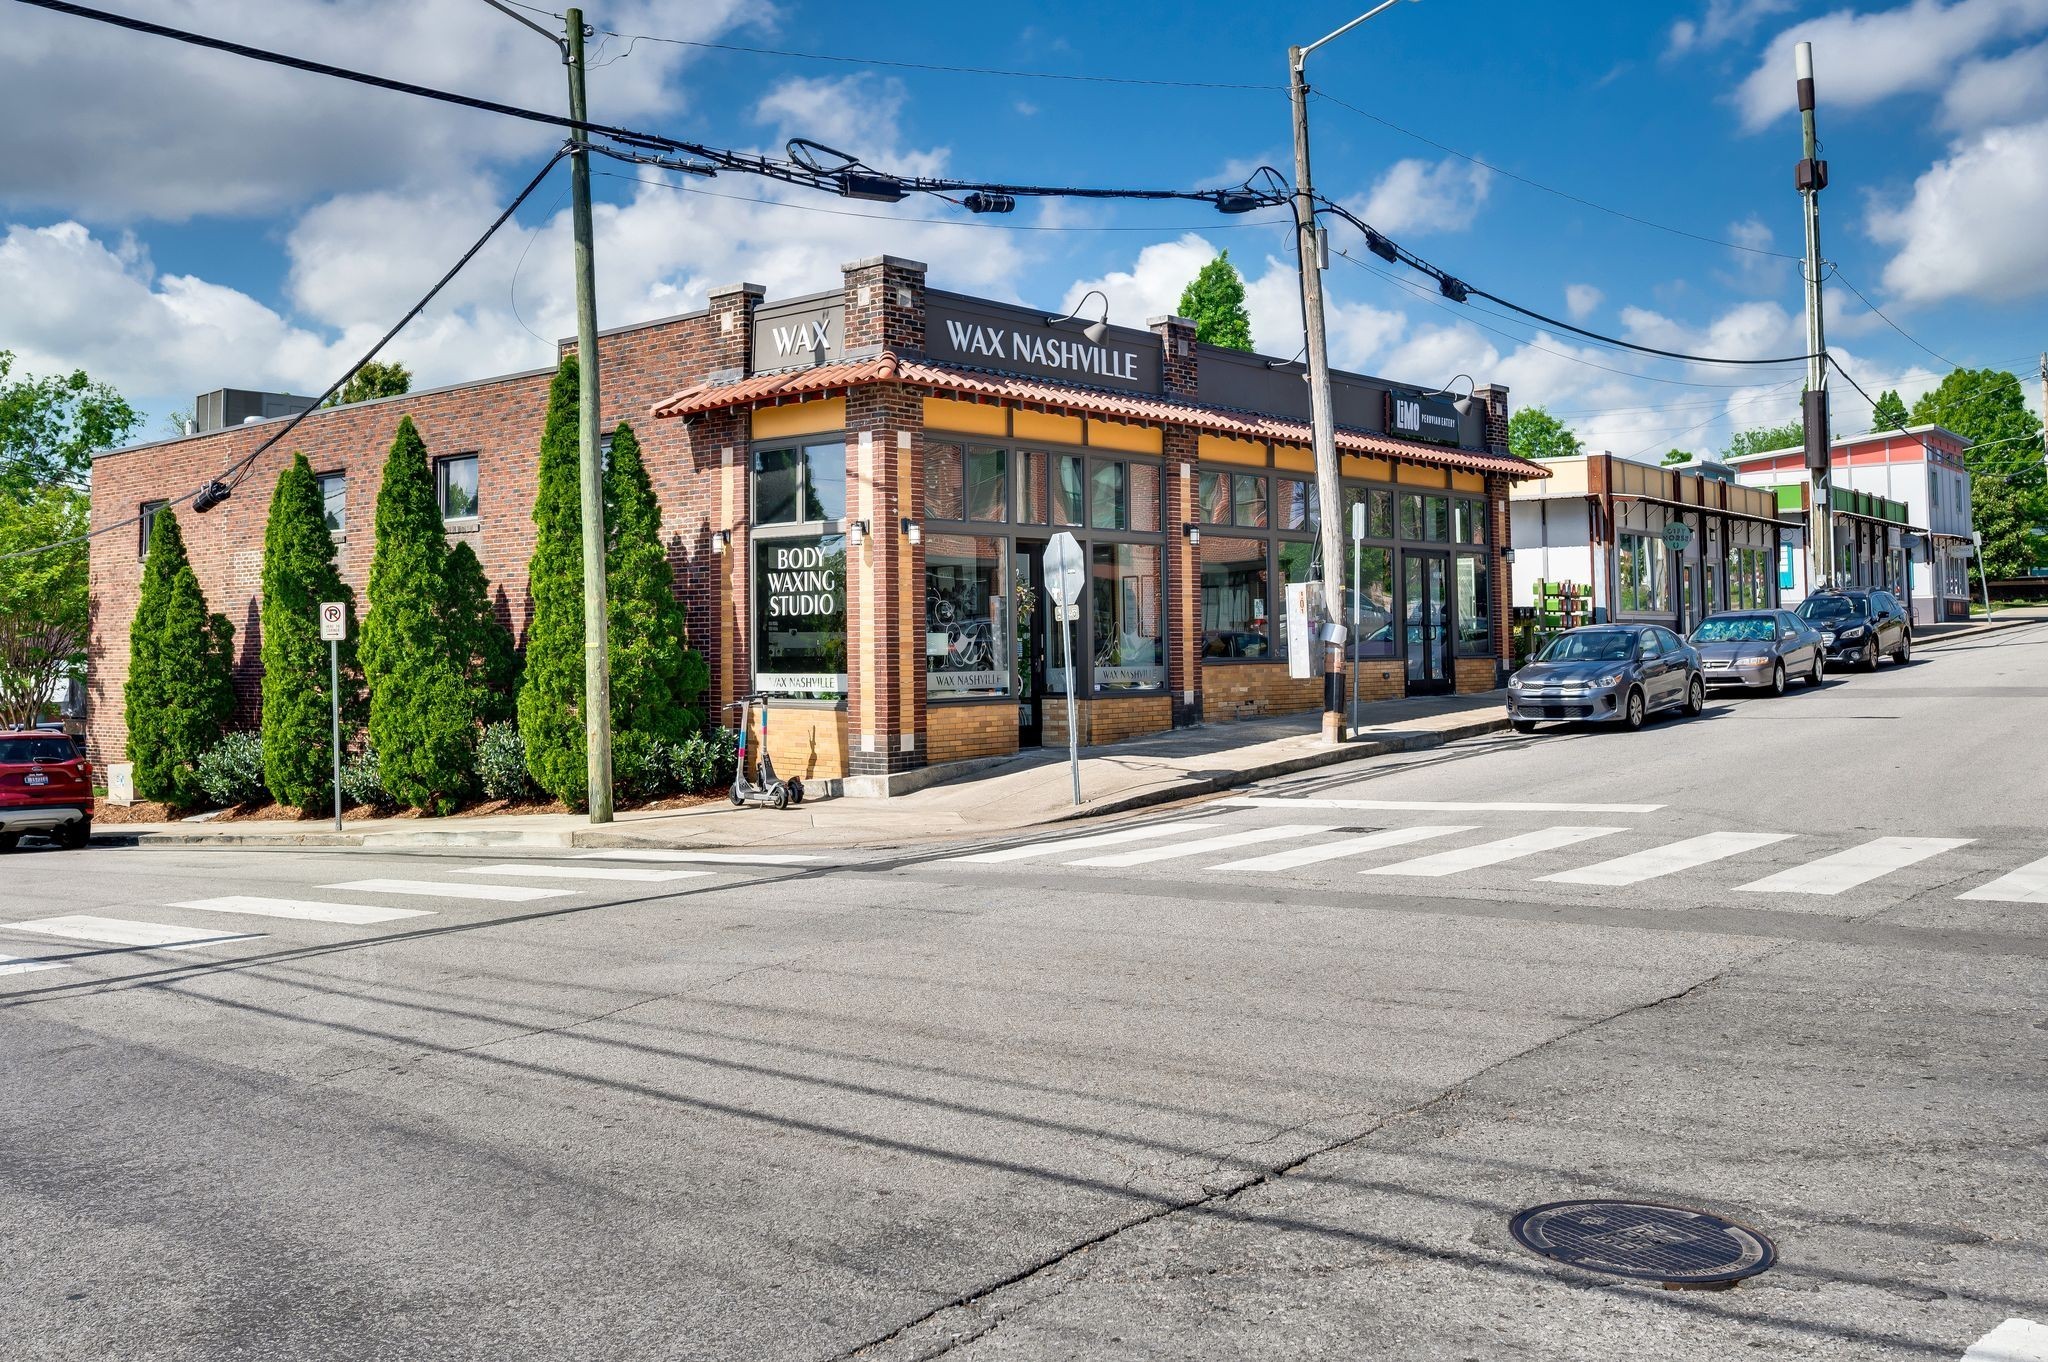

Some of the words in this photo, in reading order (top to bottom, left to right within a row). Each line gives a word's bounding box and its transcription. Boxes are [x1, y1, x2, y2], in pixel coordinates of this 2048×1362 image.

[772, 319, 830, 356] WAX
[946, 320, 1005, 359] WAX
[1013, 332, 1137, 381] NASHVILLE
[777, 546, 827, 570] BODY
[767, 570, 835, 593] WAXING
[769, 593, 834, 617] STUDIO
[789, 677, 835, 689] NASHVILLE
[936, 675, 955, 686] WAX
[1103, 669, 1119, 680] WAX
[1120, 668, 1157, 680] NASHVIL
